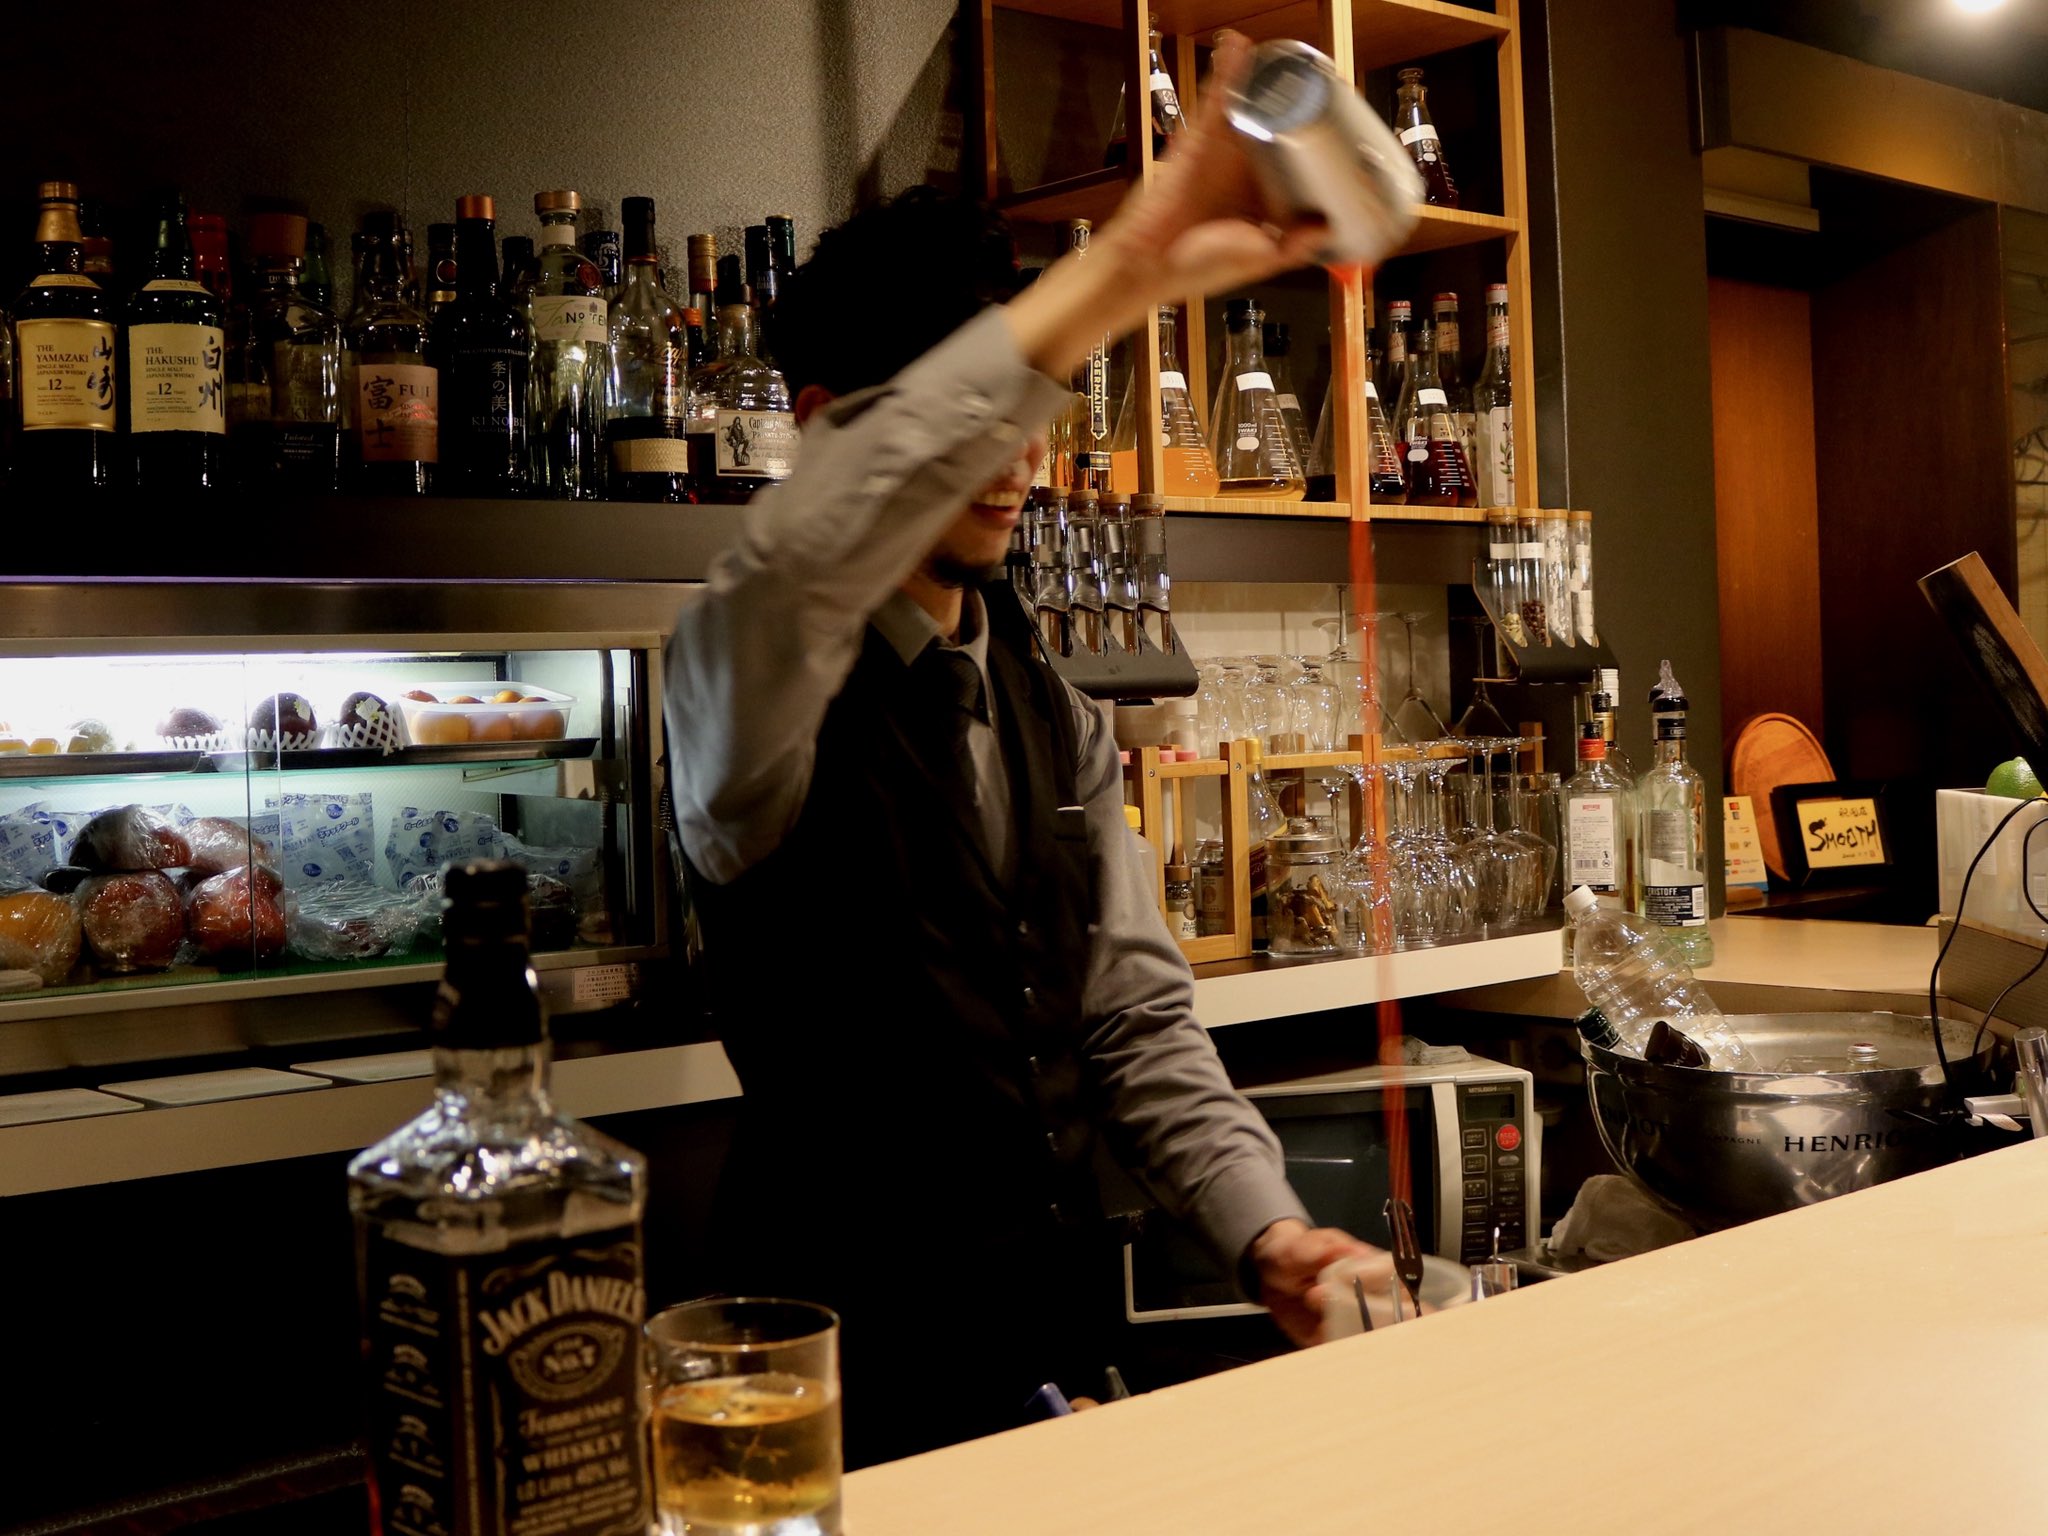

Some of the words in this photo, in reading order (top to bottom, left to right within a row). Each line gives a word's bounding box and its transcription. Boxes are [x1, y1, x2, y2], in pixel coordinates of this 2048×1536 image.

[37, 344, 54, 352] THE
[37, 353, 89, 363] YAMAZAKI
[146, 355, 199, 366] HAKUSHU
[199, 335, 224, 418] 白州
[48, 378, 62, 391] 12
[158, 382, 173, 396] 12
[400, 384, 430, 397] FUI
[363, 375, 395, 449] 富士
[1808, 817, 1879, 852] SMOOTH
[477, 1284, 550, 1358] JACK
